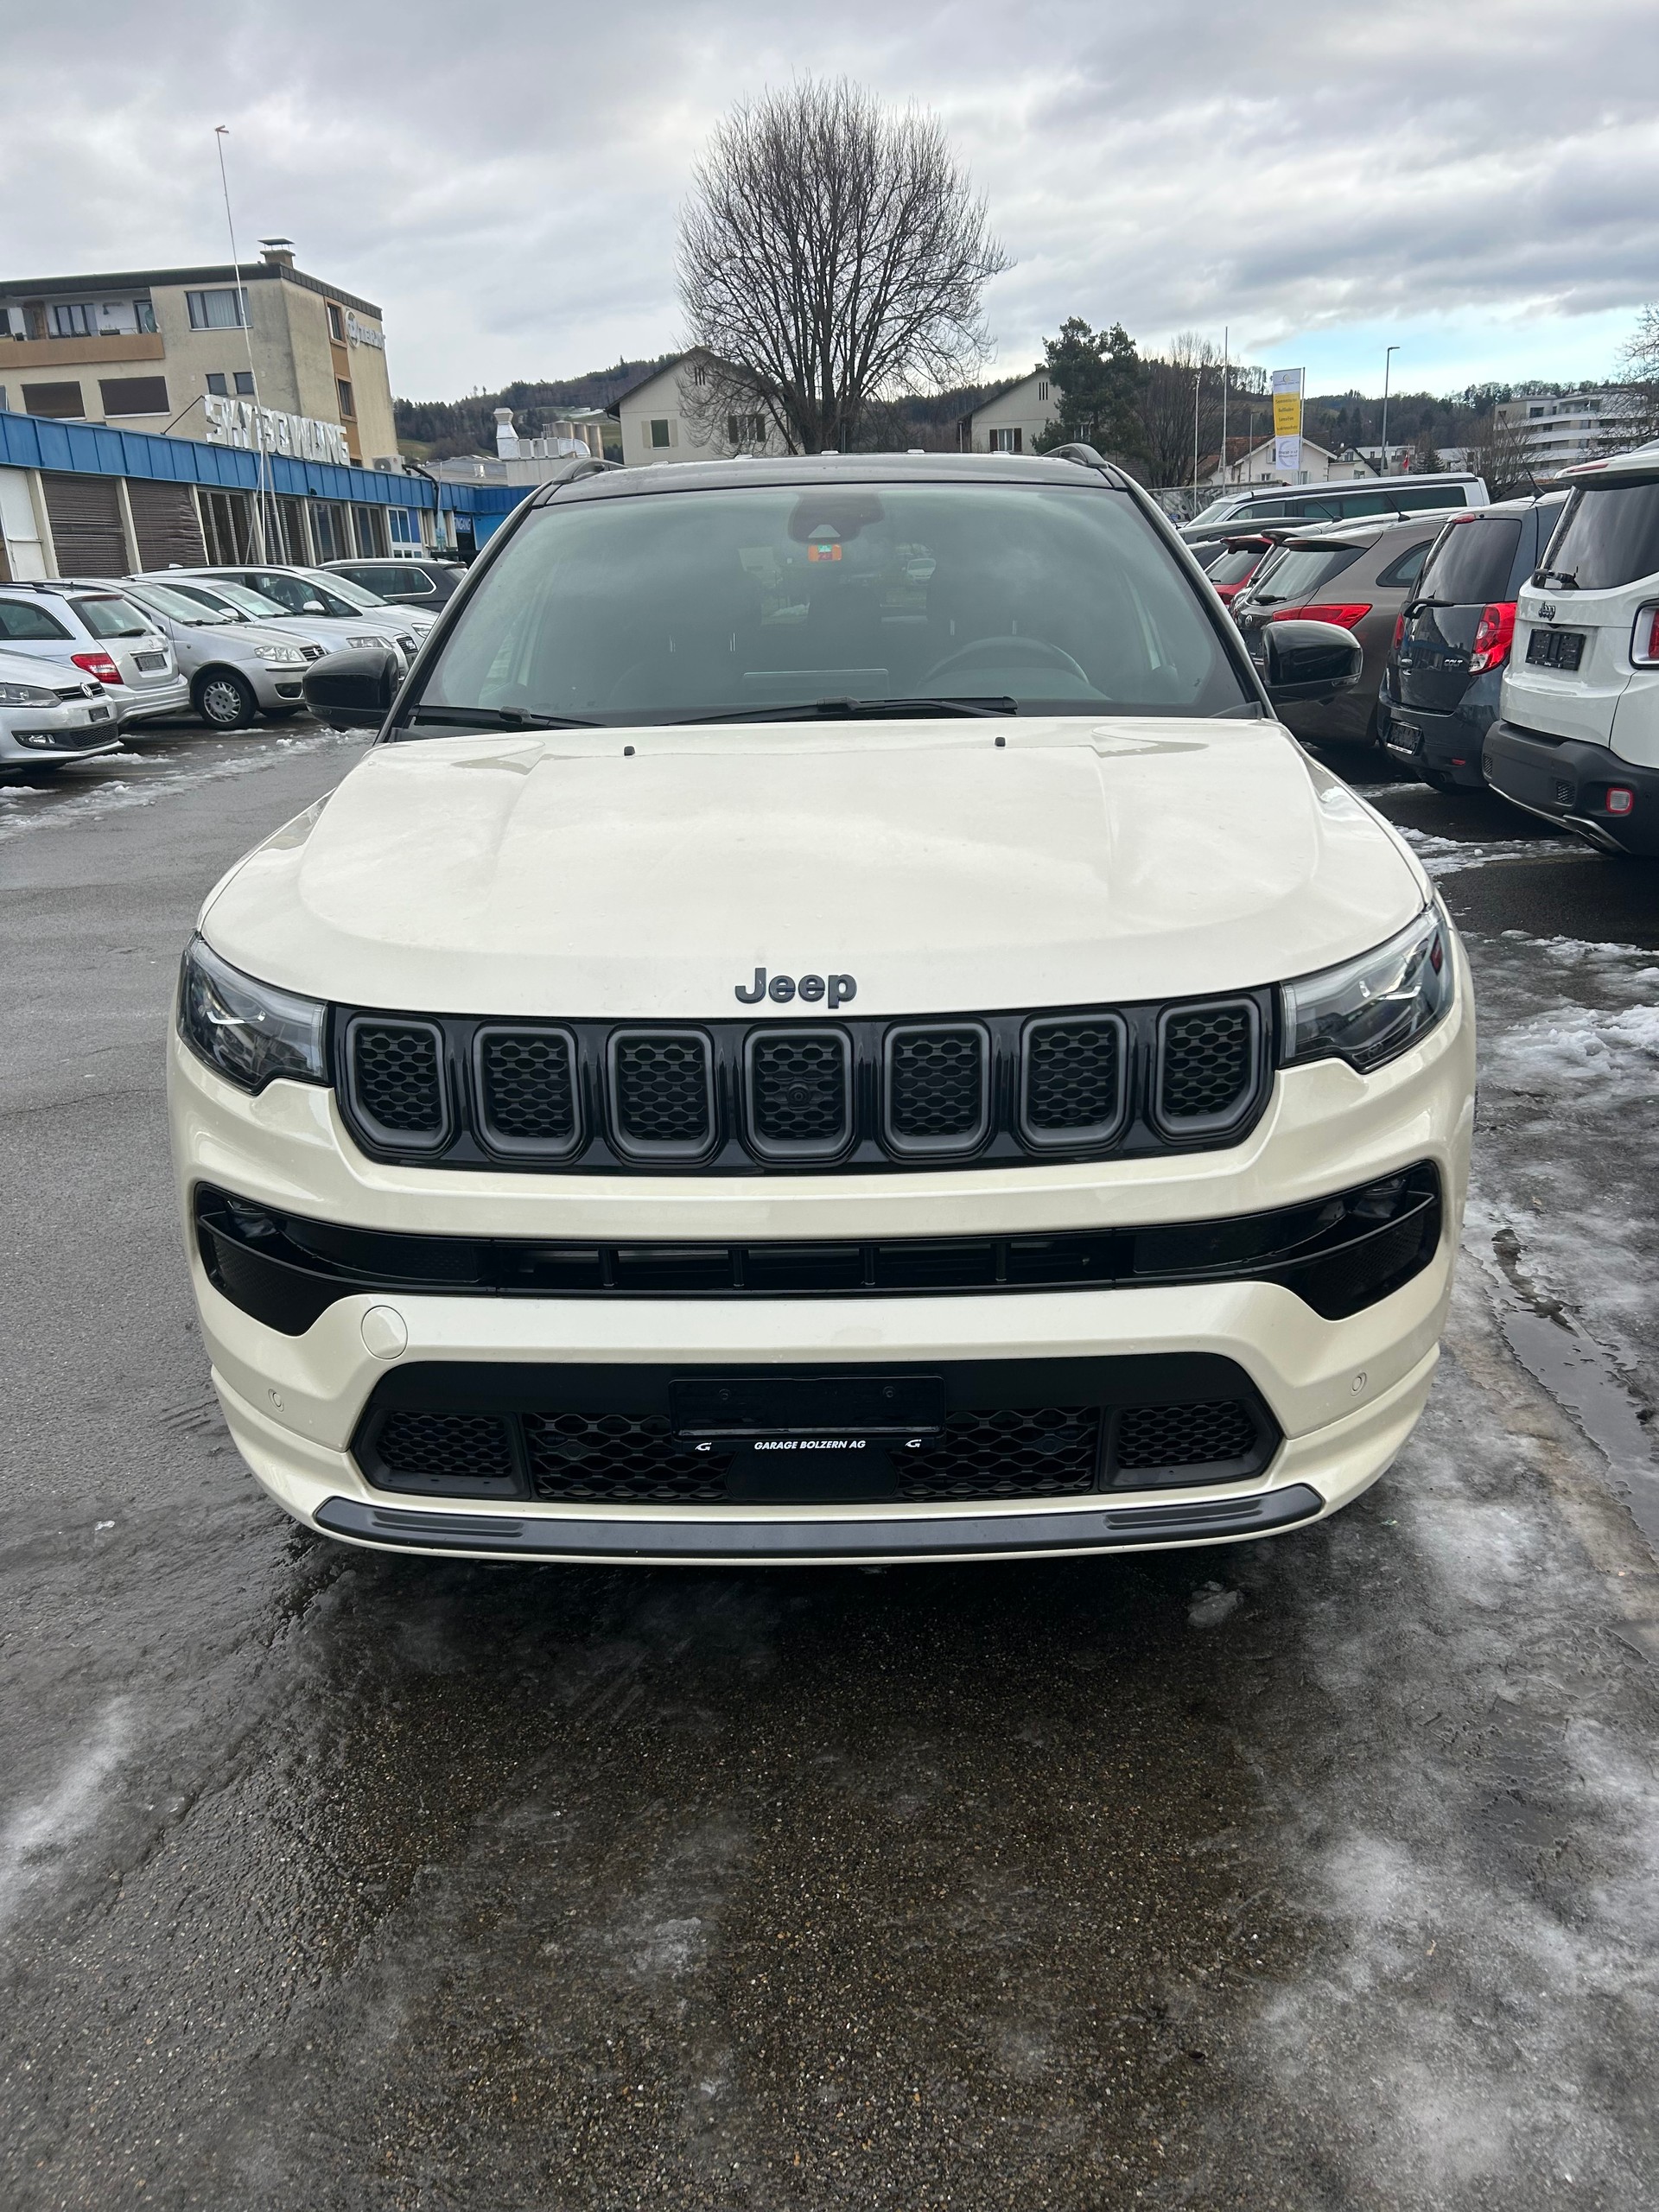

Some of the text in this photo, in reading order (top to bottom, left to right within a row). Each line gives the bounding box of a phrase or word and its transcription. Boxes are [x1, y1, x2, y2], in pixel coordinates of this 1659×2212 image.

[1538, 601, 1556, 621] Jeep
[734, 967, 858, 1009] Jeep
[753, 1440, 867, 1450] GARAGE BOLZERN AG
